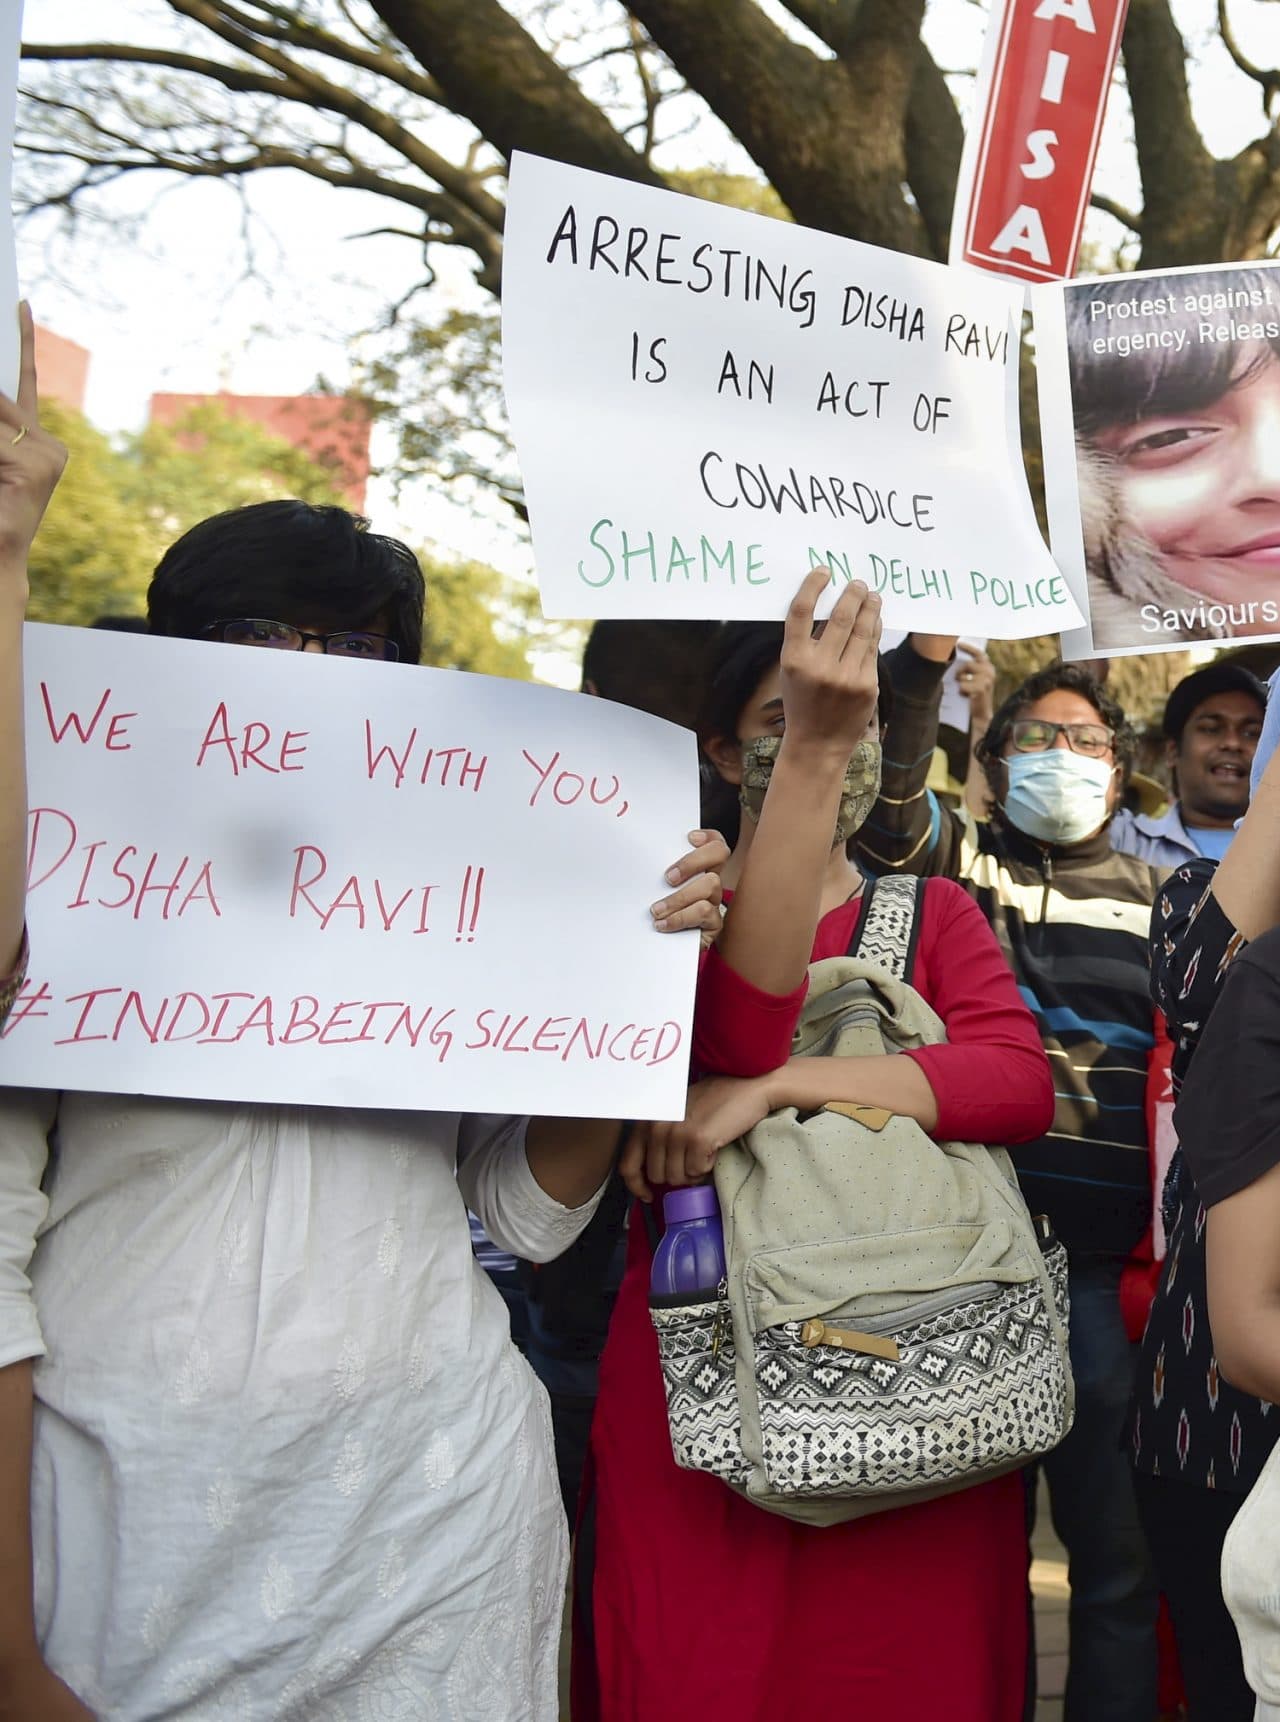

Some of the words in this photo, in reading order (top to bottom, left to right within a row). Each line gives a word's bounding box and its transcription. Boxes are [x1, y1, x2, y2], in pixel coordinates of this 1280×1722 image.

[547, 204, 815, 328] ARRESTING
[842, 286, 925, 342] DISHA
[945, 314, 1008, 364] RAVI
[1090, 298, 1177, 323] Protest
[1184, 287, 1273, 318] against
[631, 332, 667, 383] IS
[717, 350, 774, 404] AN
[817, 371, 890, 419] ACT
[913, 393, 951, 434] OF
[1092, 329, 1190, 357] ergency.
[700, 451, 935, 532] COWARDICE
[578, 518, 771, 588] SHAME
[868, 553, 953, 601] DELHI
[970, 571, 1067, 610] POLICE
[1140, 601, 1278, 633] Saviours
[40, 682, 138, 751] WE
[196, 702, 310, 776] ARE
[365, 719, 488, 792] WITH
[522, 749, 629, 818] YOU,
[27, 808, 221, 919] DISHA
[289, 845, 485, 943] RAVI!!
